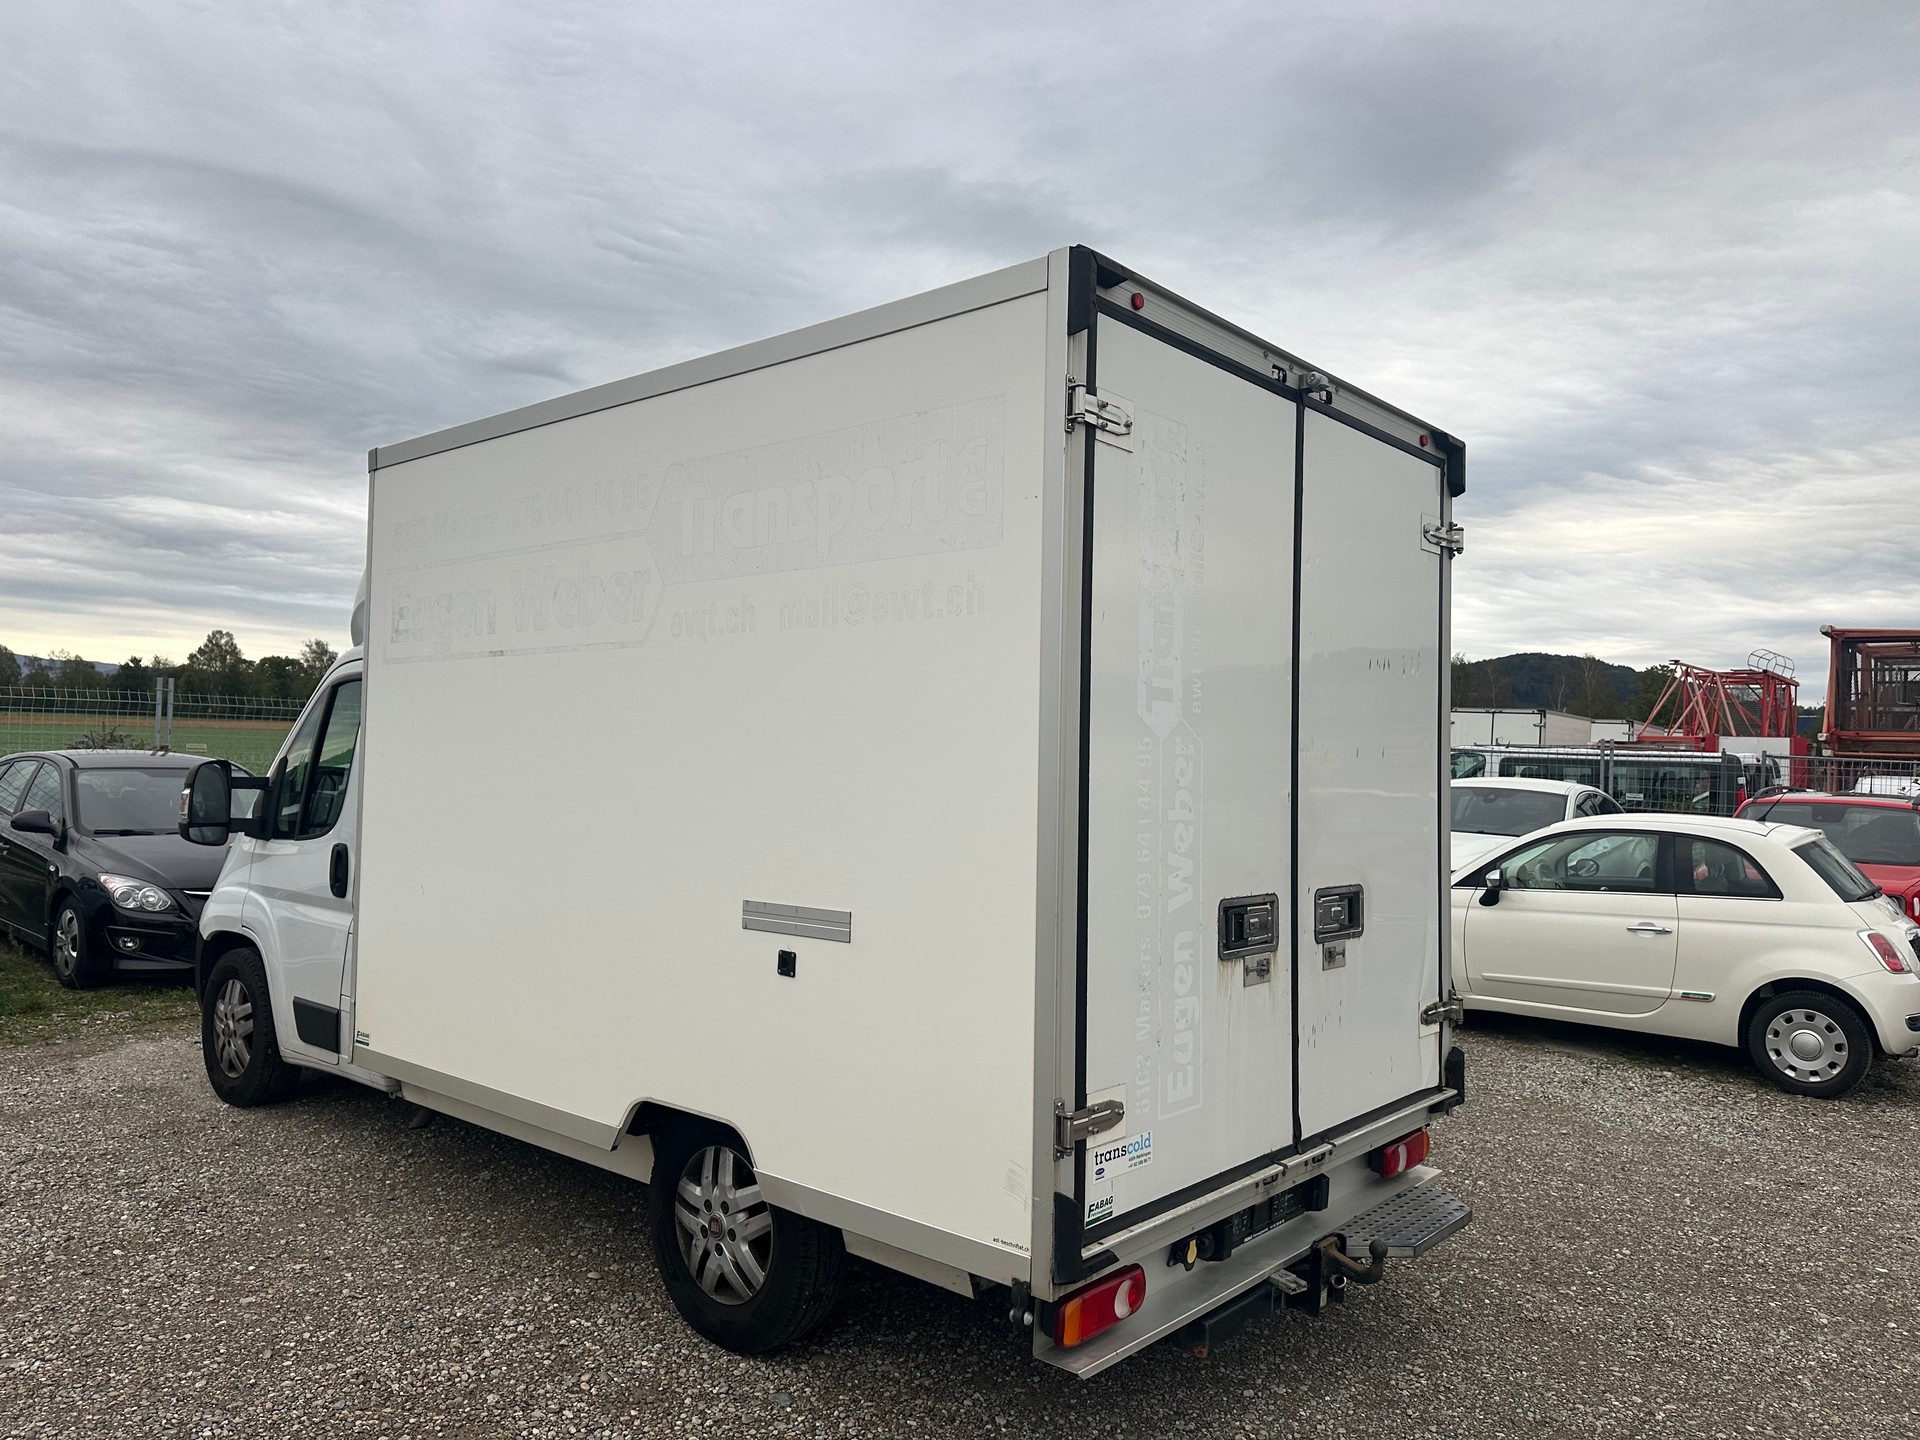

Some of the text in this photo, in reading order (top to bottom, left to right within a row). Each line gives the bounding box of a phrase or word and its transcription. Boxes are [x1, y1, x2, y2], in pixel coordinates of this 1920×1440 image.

[672, 439, 949, 558] Transport
[390, 560, 651, 656] Eugen Weber
[669, 570, 986, 635] ewt.ch mail@ewt.ch
[1136, 776, 1153, 810] 44
[1136, 818, 1153, 863] 641
[1136, 872, 1153, 920] 079
[1167, 736, 1199, 1104] Eugen Weber
[1094, 1132, 1152, 1166] transcold
[1087, 1195, 1114, 1219] FABAG
